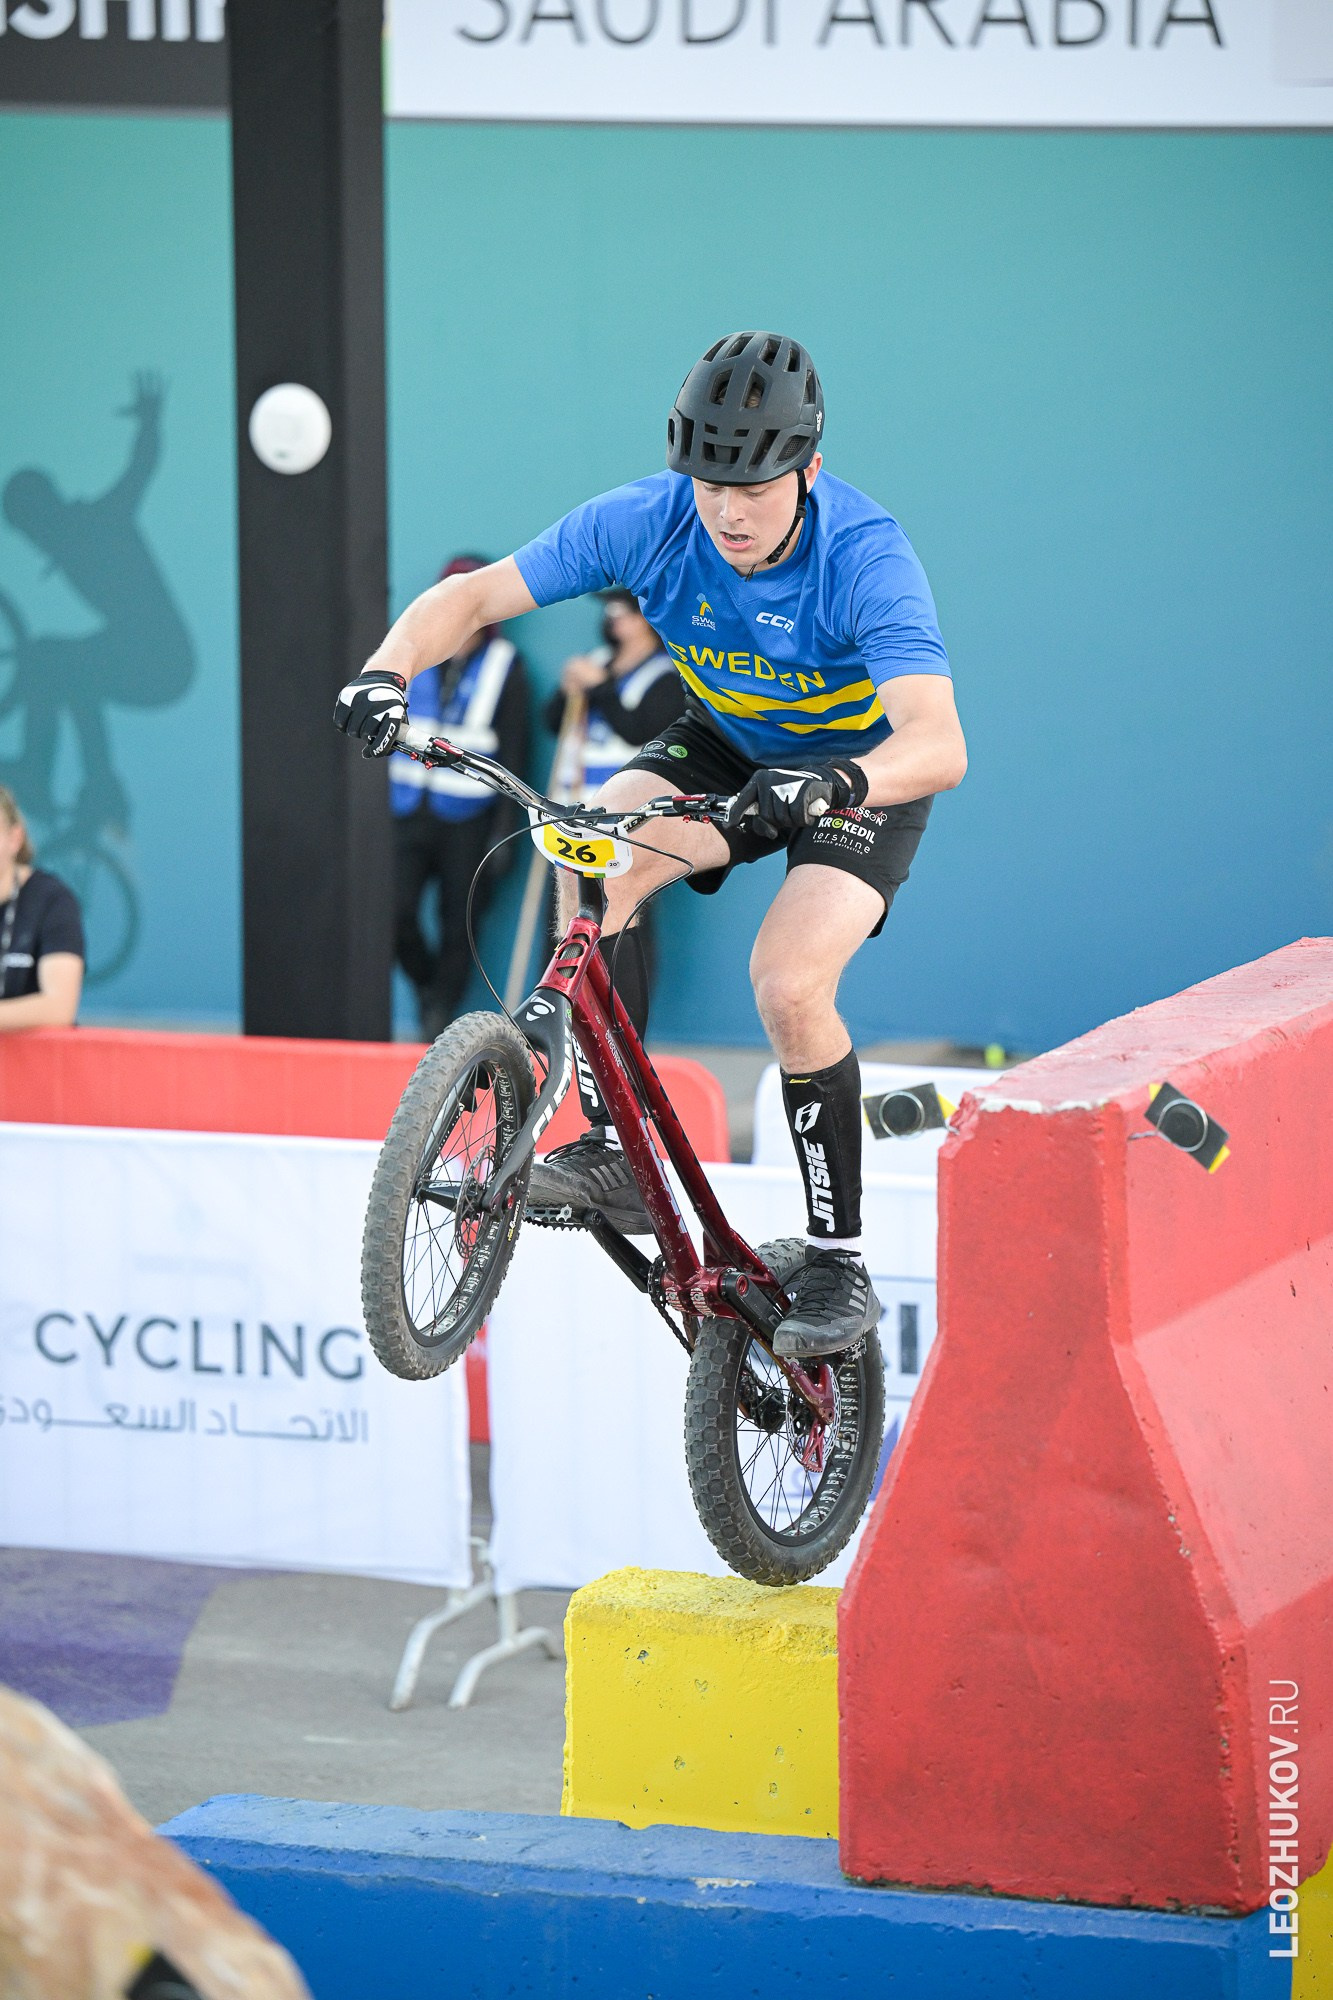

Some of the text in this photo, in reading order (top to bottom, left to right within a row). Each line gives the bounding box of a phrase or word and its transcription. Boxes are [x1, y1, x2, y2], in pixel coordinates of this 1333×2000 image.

[815, 0, 1227, 48] ARABIA
[667, 640, 826, 694] SWEDEN
[556, 838, 597, 863] 26
[818, 816, 876, 844] KROKEDIL
[34, 1311, 366, 1382] CYCLING
[0, 1398, 196, 1433] السعود
